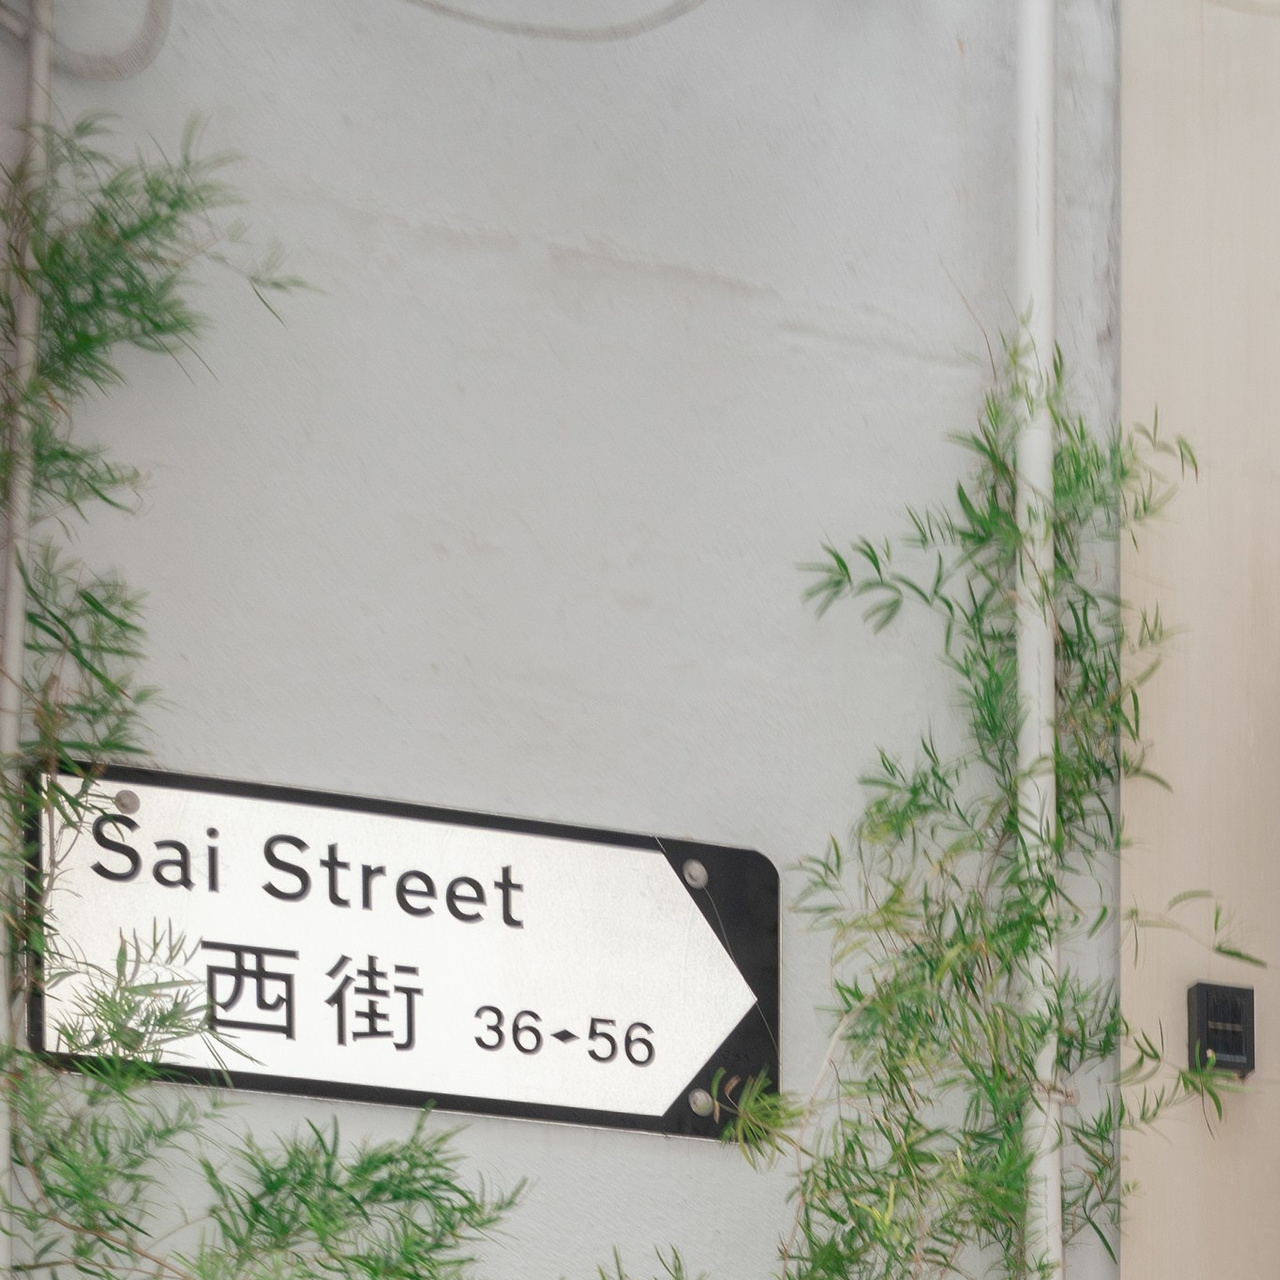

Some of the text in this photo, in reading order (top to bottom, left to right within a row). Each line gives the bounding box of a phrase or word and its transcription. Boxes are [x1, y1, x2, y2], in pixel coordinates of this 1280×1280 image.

[90, 813, 524, 928] Sai Street
[200, 939, 424, 1052] 西街
